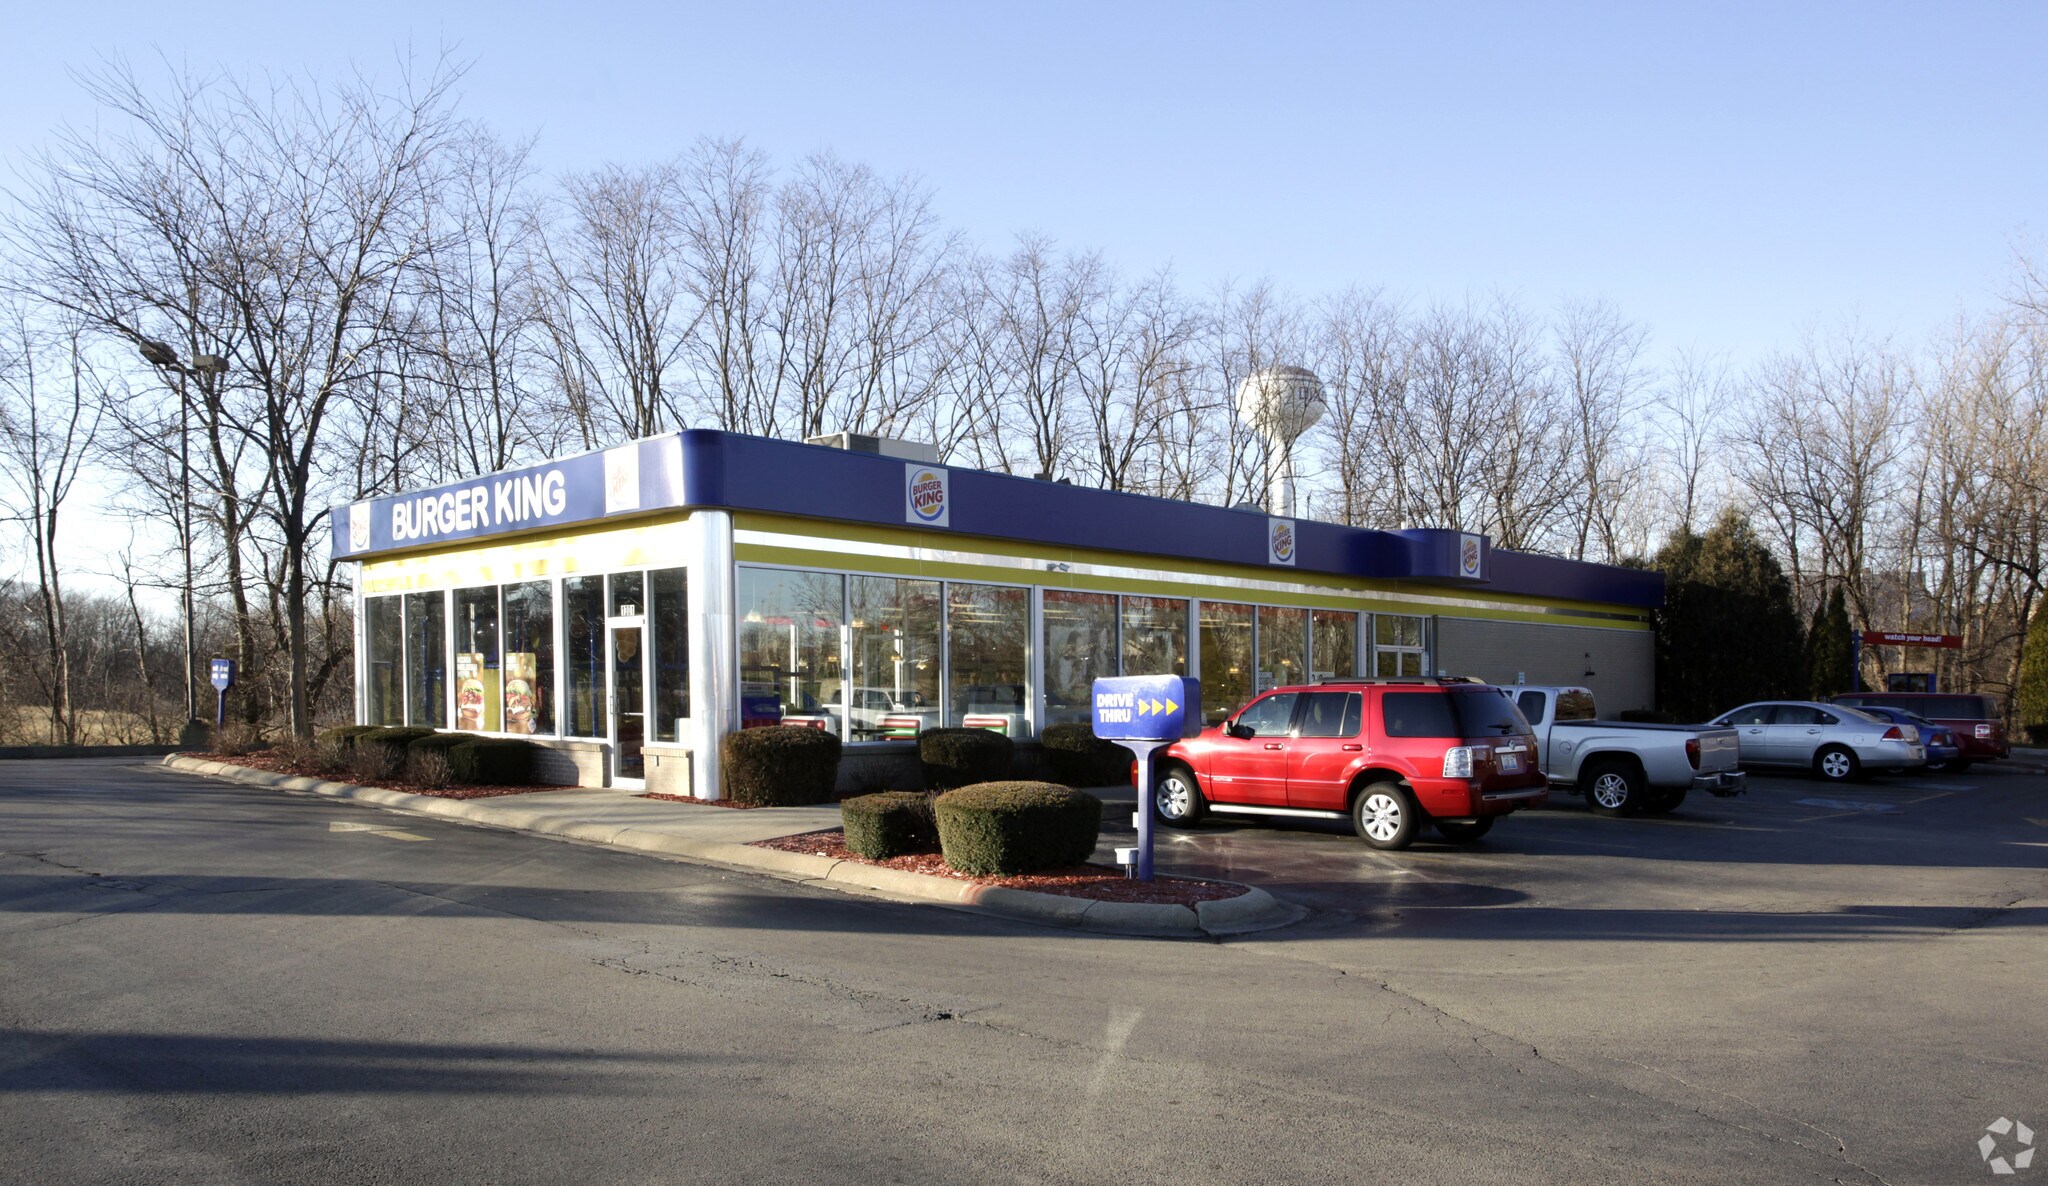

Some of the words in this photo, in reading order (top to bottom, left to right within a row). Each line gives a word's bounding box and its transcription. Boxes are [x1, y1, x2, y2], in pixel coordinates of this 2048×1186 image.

[913, 480, 942, 496] BURGER
[392, 485, 490, 541] BURGER
[494, 469, 566, 525] KING
[914, 490, 943, 509] KING
[1273, 528, 1290, 544] BURGER
[1274, 535, 1292, 553] KING
[1884, 633, 1905, 641] watch
[1922, 634, 1942, 643] head!
[1096, 693, 1134, 707] DRIVE
[1098, 709, 1131, 723] THRU
